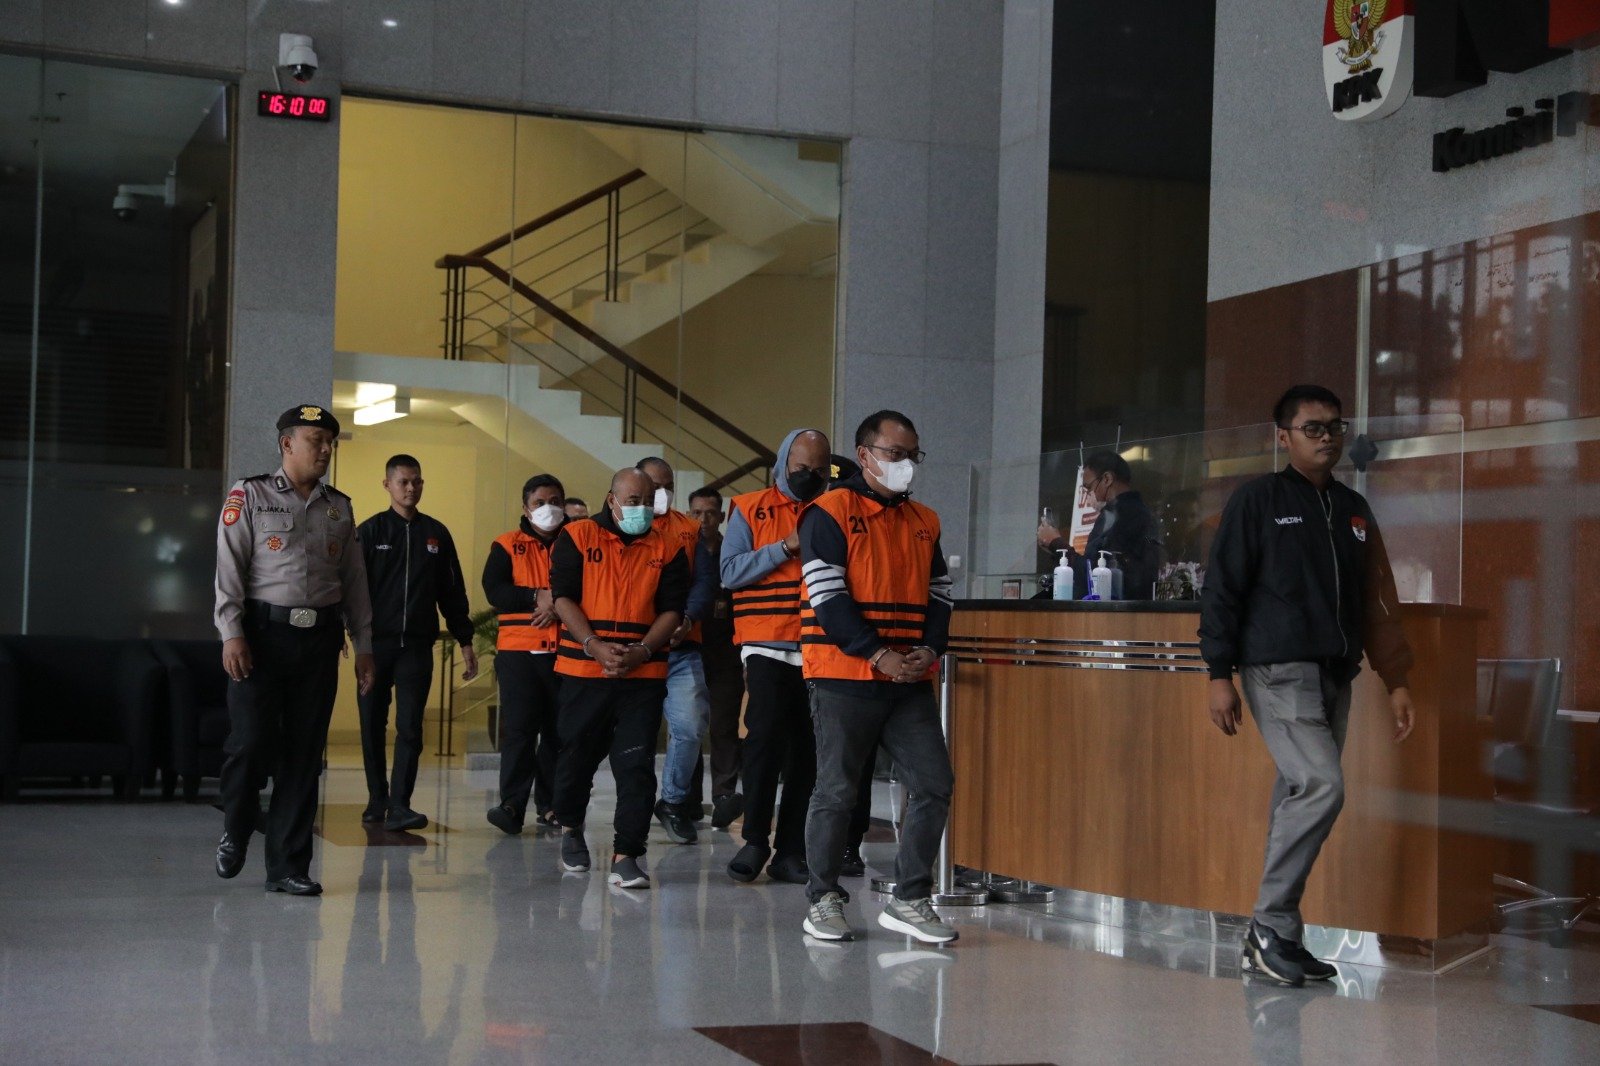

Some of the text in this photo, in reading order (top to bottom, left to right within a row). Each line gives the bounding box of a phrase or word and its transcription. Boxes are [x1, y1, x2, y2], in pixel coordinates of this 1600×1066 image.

[1333, 67, 1384, 113] KPK
[269, 94, 326, 116] 16:10 00
[755, 506, 774, 520] 61
[848, 515, 869, 535] 21
[512, 543, 526, 555] 19
[586, 547, 603, 563] 10
